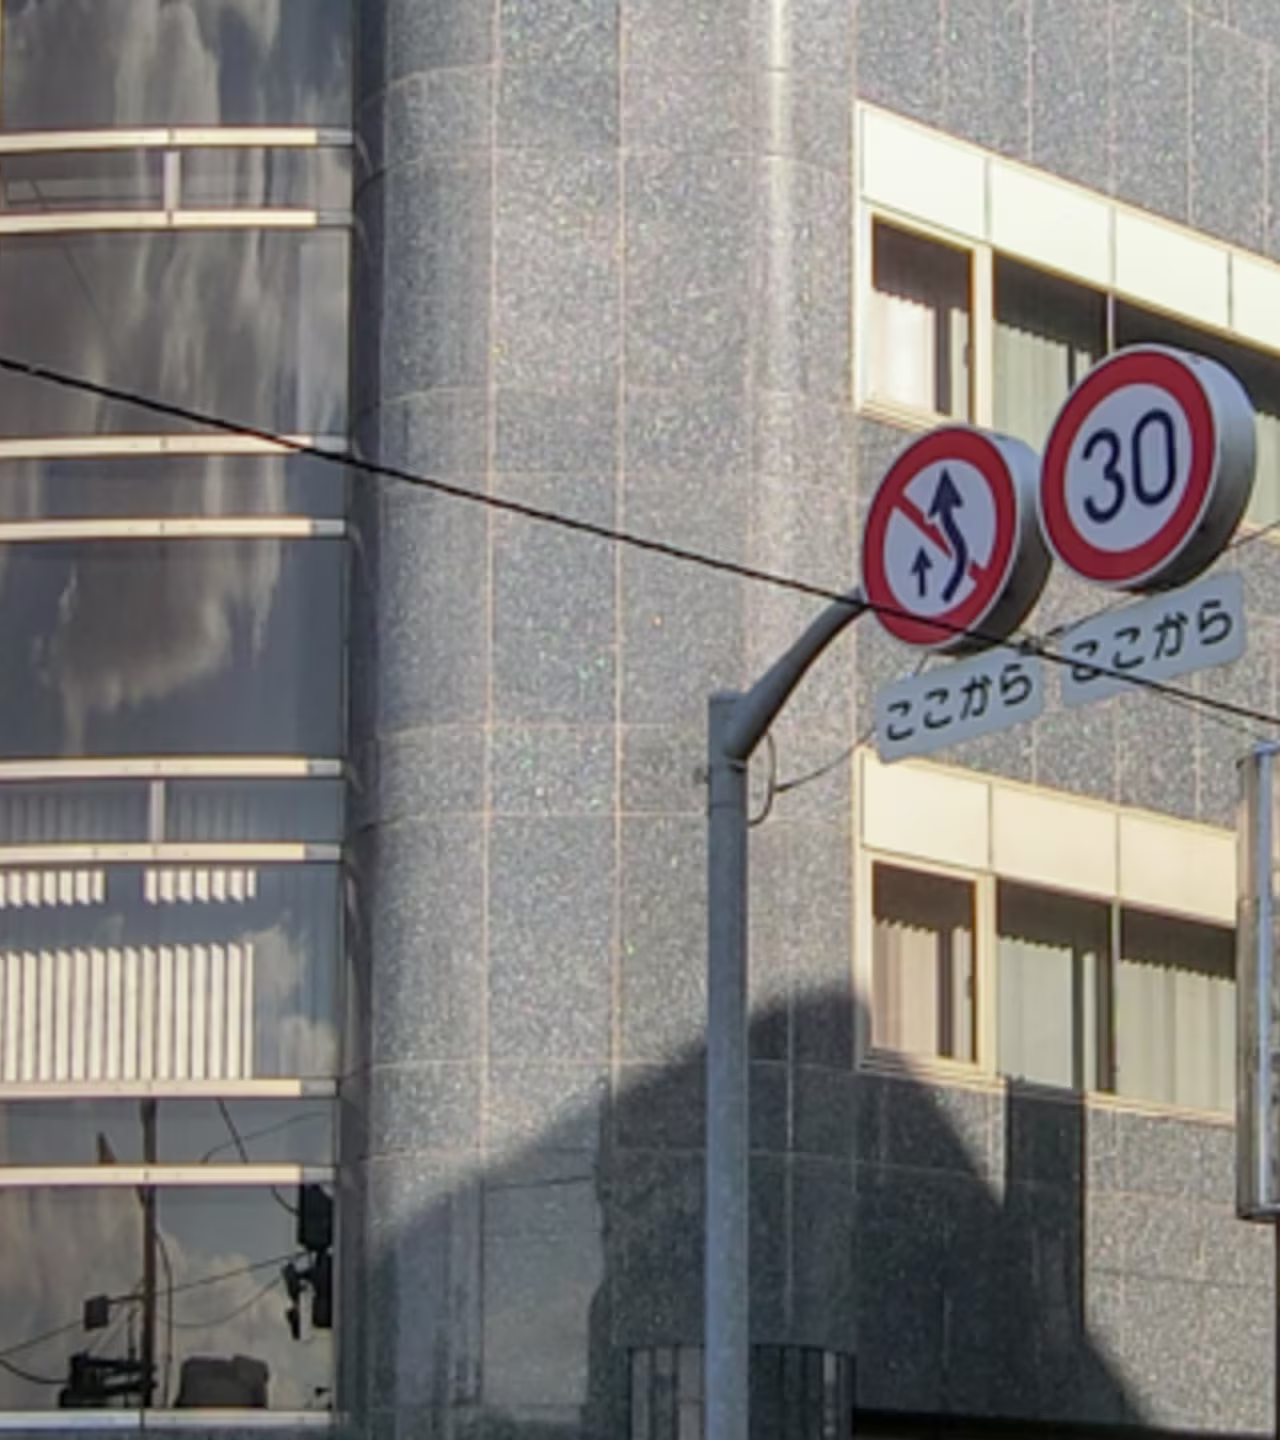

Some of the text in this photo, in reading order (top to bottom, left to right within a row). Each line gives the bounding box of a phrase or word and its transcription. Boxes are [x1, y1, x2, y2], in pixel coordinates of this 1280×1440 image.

[1081, 408, 1178, 524] 30
[1072, 600, 1233, 683] ここから
[886, 663, 1033, 742] ここから
